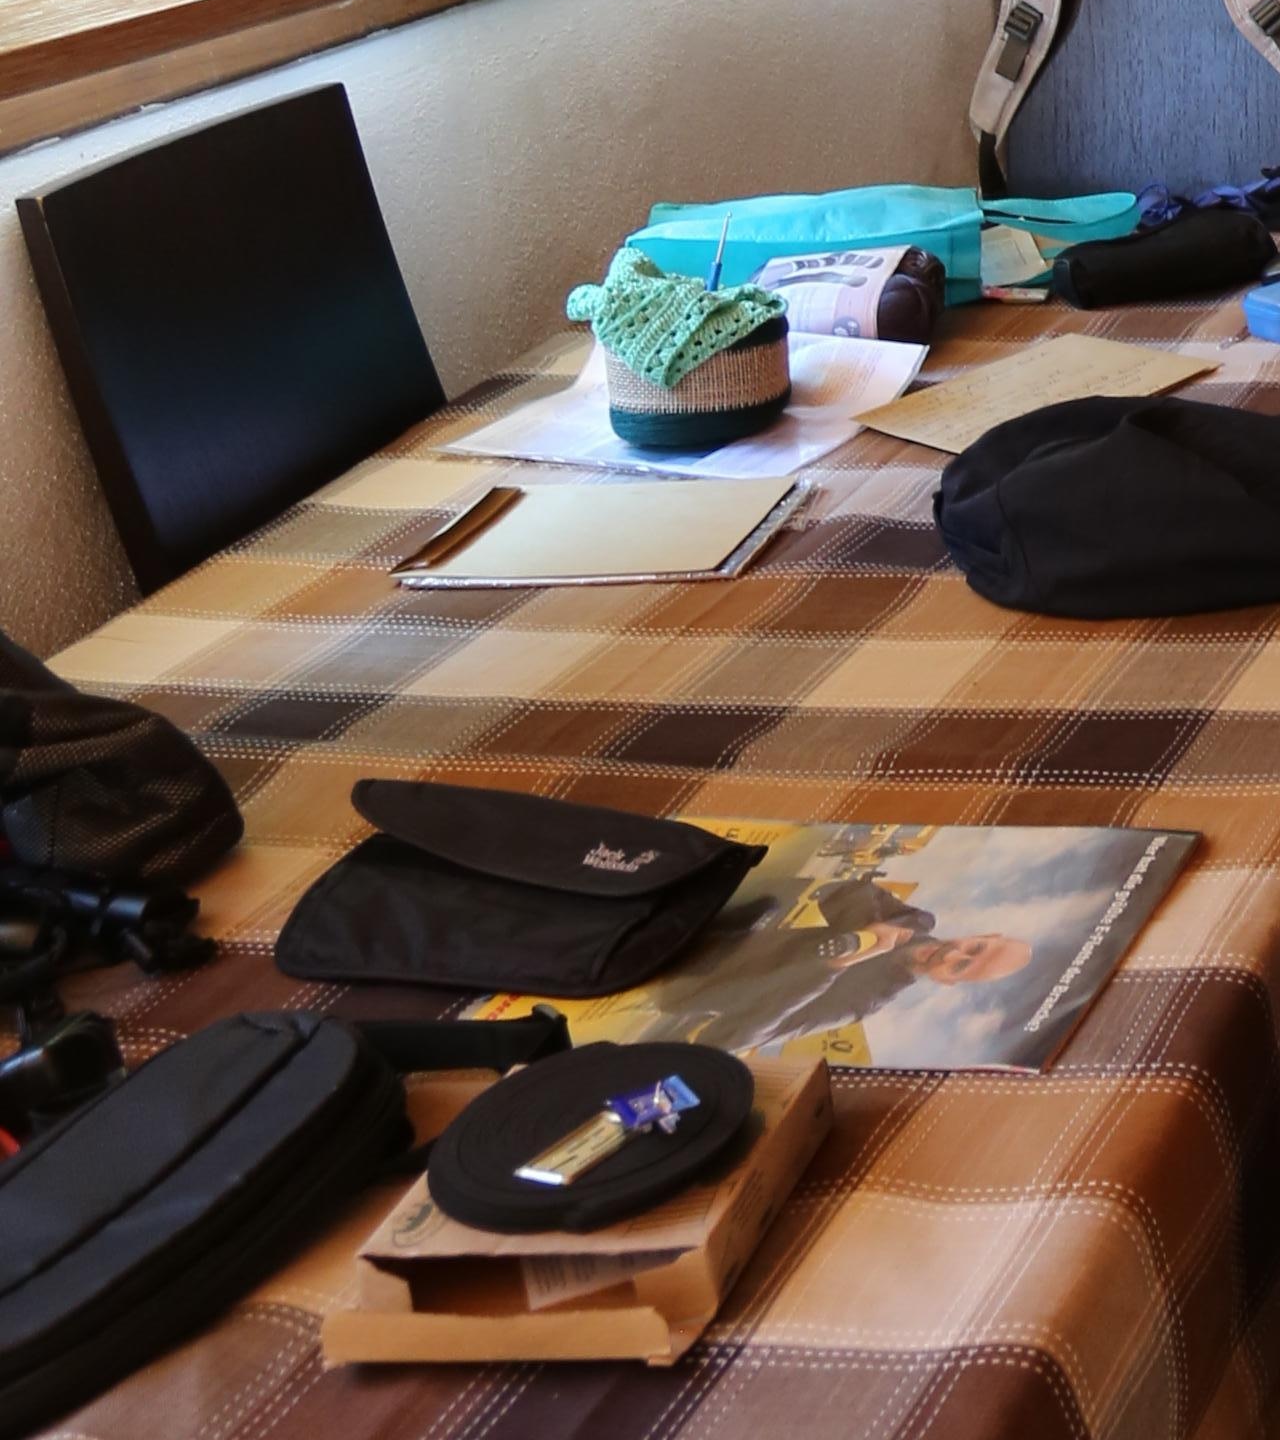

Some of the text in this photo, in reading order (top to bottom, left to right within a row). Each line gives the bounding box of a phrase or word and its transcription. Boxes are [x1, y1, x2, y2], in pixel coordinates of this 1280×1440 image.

[1145, 836, 1168, 855] Wer
[1133, 855, 1156, 873] hat
[1123, 873, 1144, 890] die
[1059, 966, 1081, 984] der
